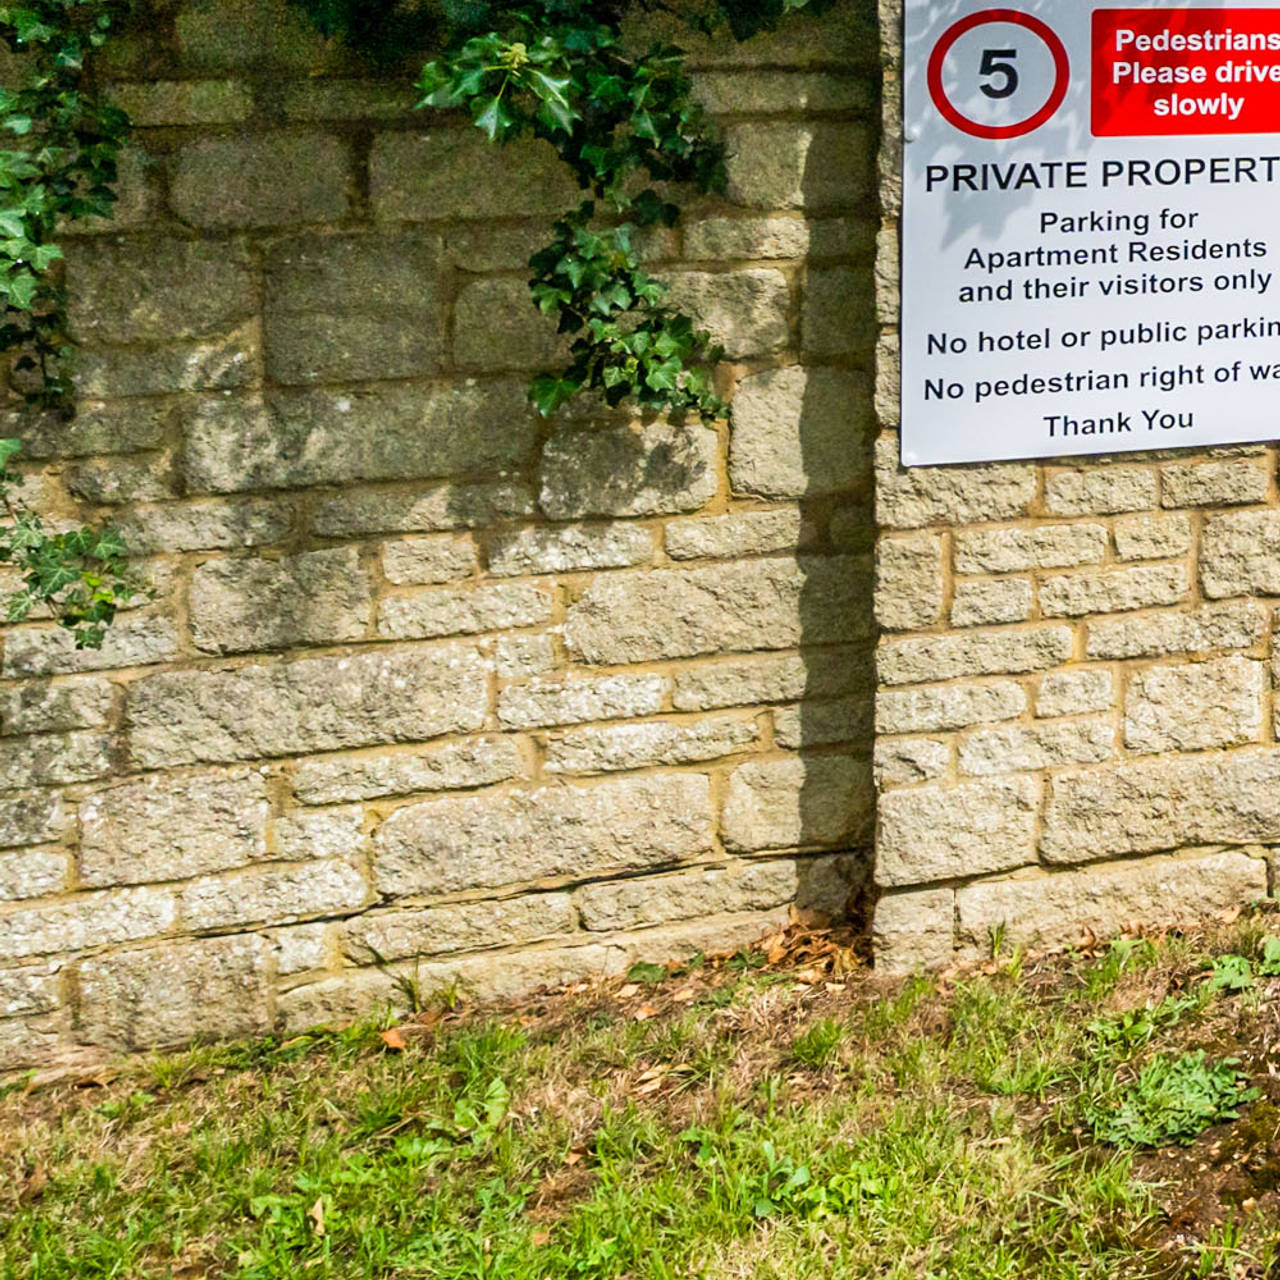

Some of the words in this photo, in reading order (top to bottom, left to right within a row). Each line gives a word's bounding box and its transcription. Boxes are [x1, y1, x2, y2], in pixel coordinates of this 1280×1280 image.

[978, 49, 1019, 100] 5
[1112, 61, 1206, 84] Please
[1154, 93, 1244, 120] slowly
[925, 162, 1087, 191] PRIVATE
[1040, 211, 1149, 236] Parking
[1160, 209, 1199, 229] for
[964, 246, 1118, 274] Apartment
[1129, 239, 1267, 262] Residents
[959, 280, 1013, 303] and
[1024, 278, 1089, 299] their
[1099, 273, 1203, 296] visitors
[1214, 270, 1273, 294] only
[927, 333, 966, 356] No
[978, 328, 1050, 352] hotel
[1061, 329, 1090, 348] or
[1100, 321, 1188, 351] public
[924, 378, 963, 400] No
[975, 369, 1128, 403] pedestrian
[1140, 364, 1204, 392] right
[1214, 361, 1241, 383] of
[1044, 412, 1131, 437] Thank
[1141, 410, 1194, 430] You
